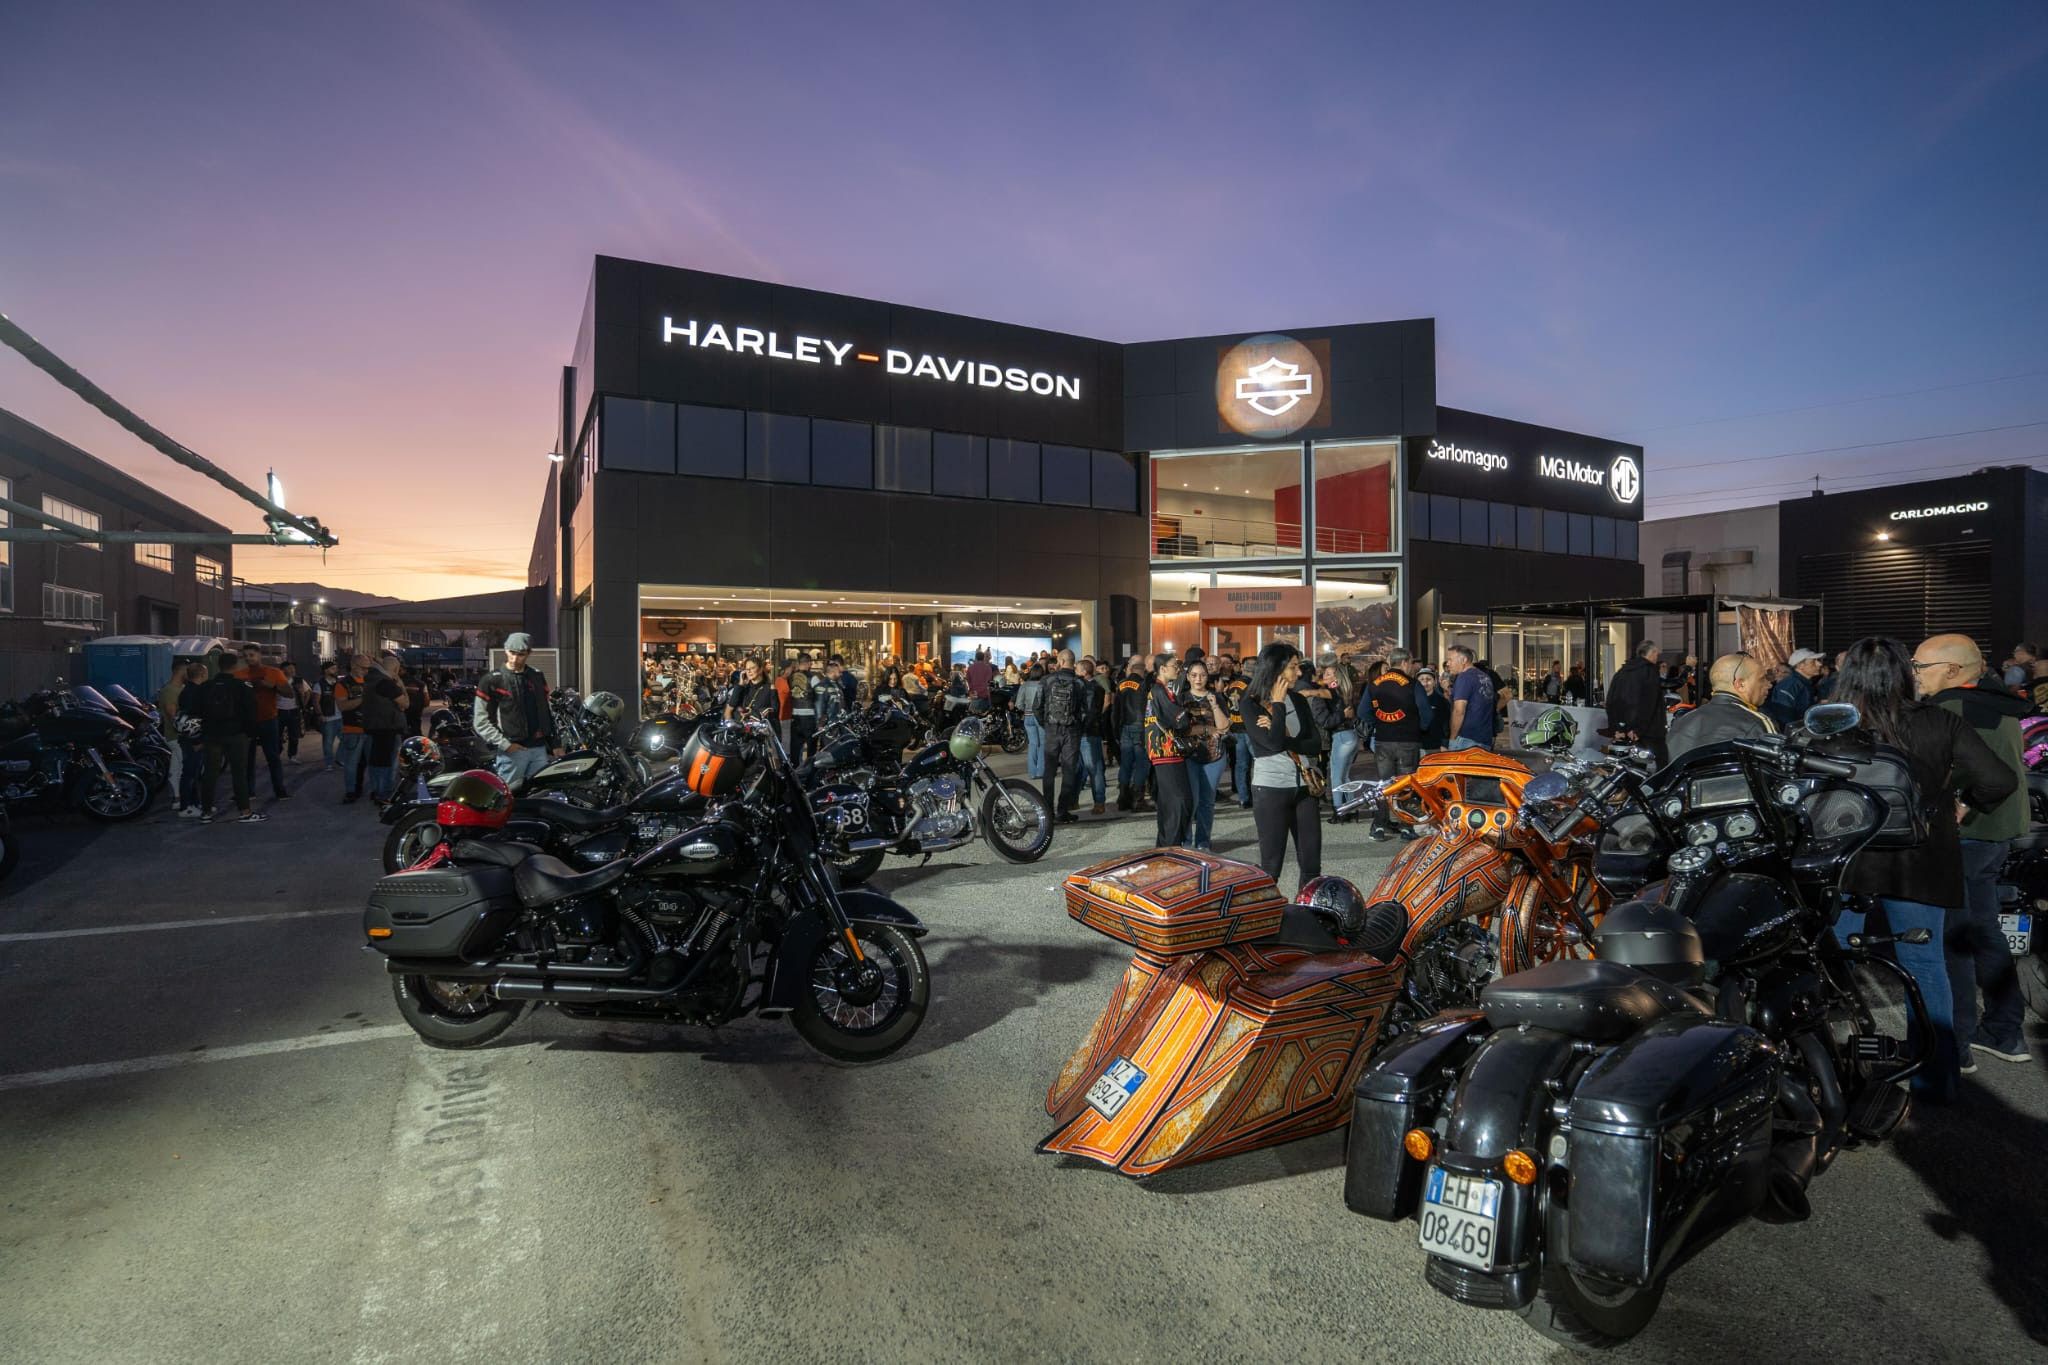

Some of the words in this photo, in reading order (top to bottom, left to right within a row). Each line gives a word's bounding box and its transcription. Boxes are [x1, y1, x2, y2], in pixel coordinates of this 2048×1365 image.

[1427, 439, 1508, 472] Carlomagno
[1889, 501, 1989, 521] CARLOMAGNO
[1442, 1175, 1471, 1208] EH
[1422, 1210, 1491, 1259] 08469
